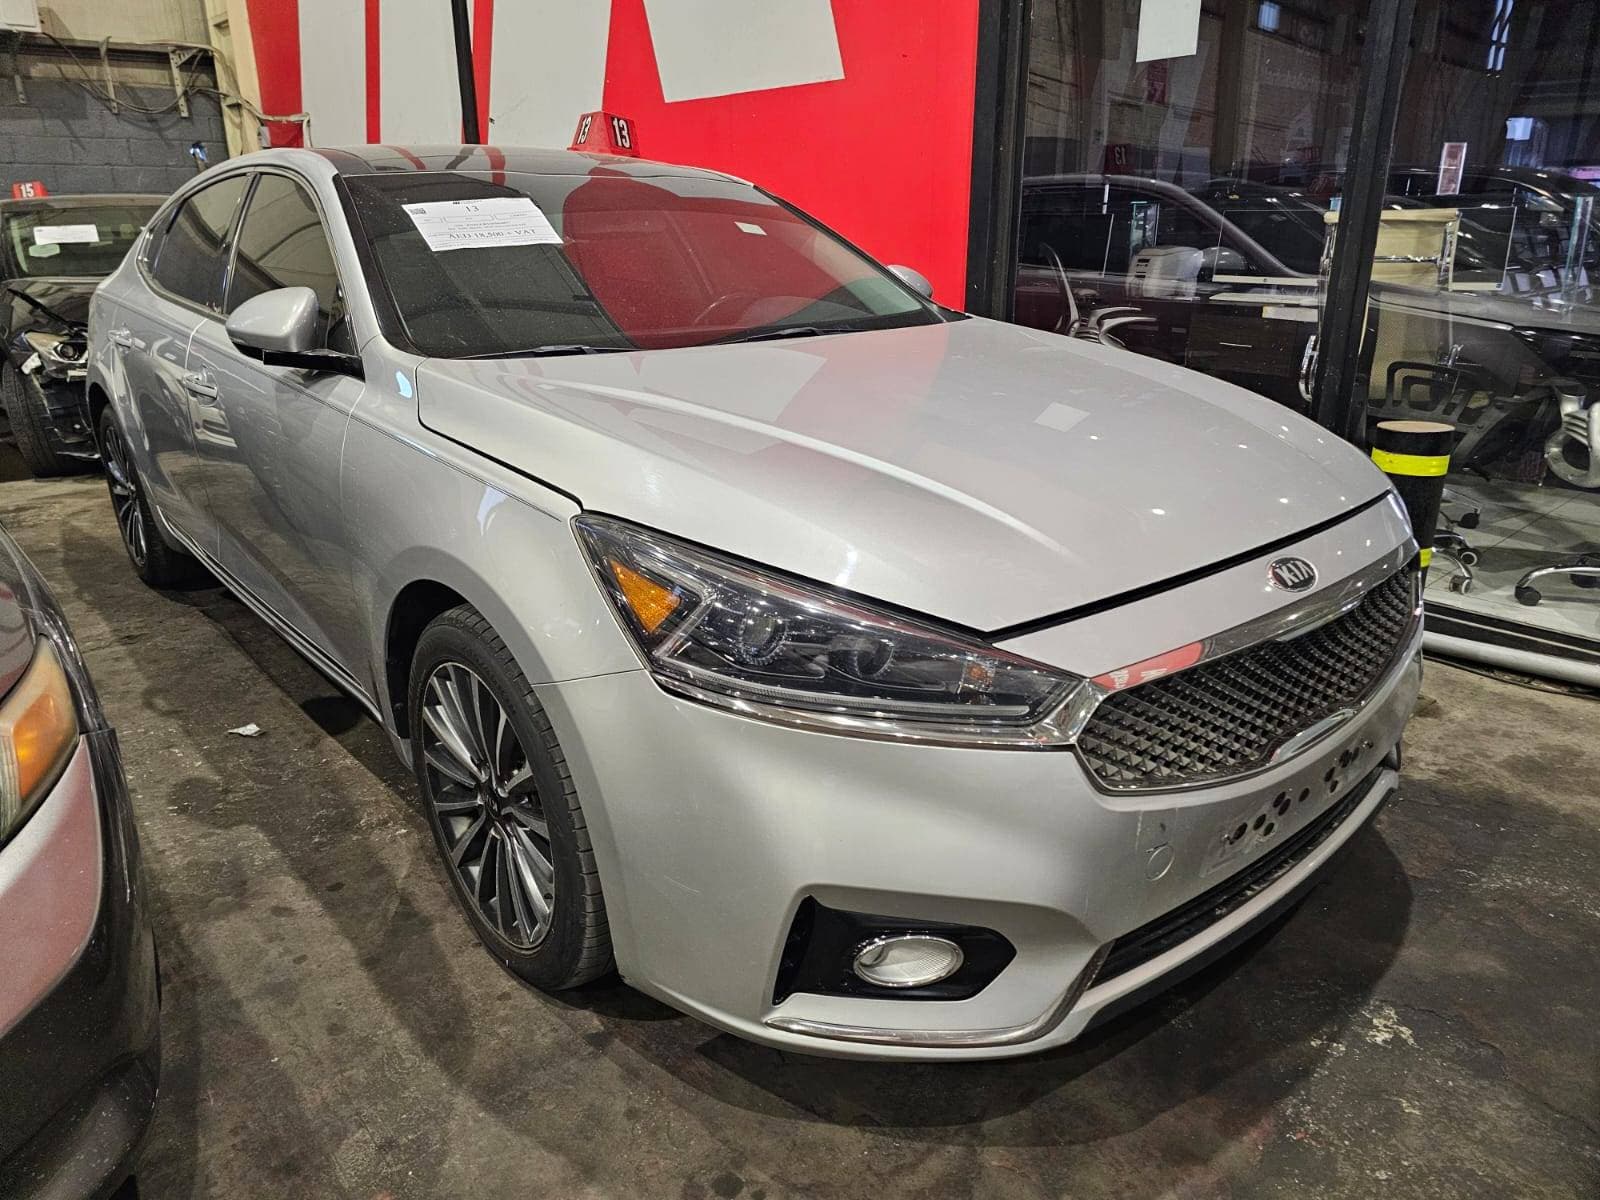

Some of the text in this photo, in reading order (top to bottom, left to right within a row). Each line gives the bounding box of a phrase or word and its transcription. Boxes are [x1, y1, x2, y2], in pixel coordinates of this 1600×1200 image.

[612, 116, 631, 149] 13
[20, 182, 35, 198] 15
[465, 205, 480, 213] 13
